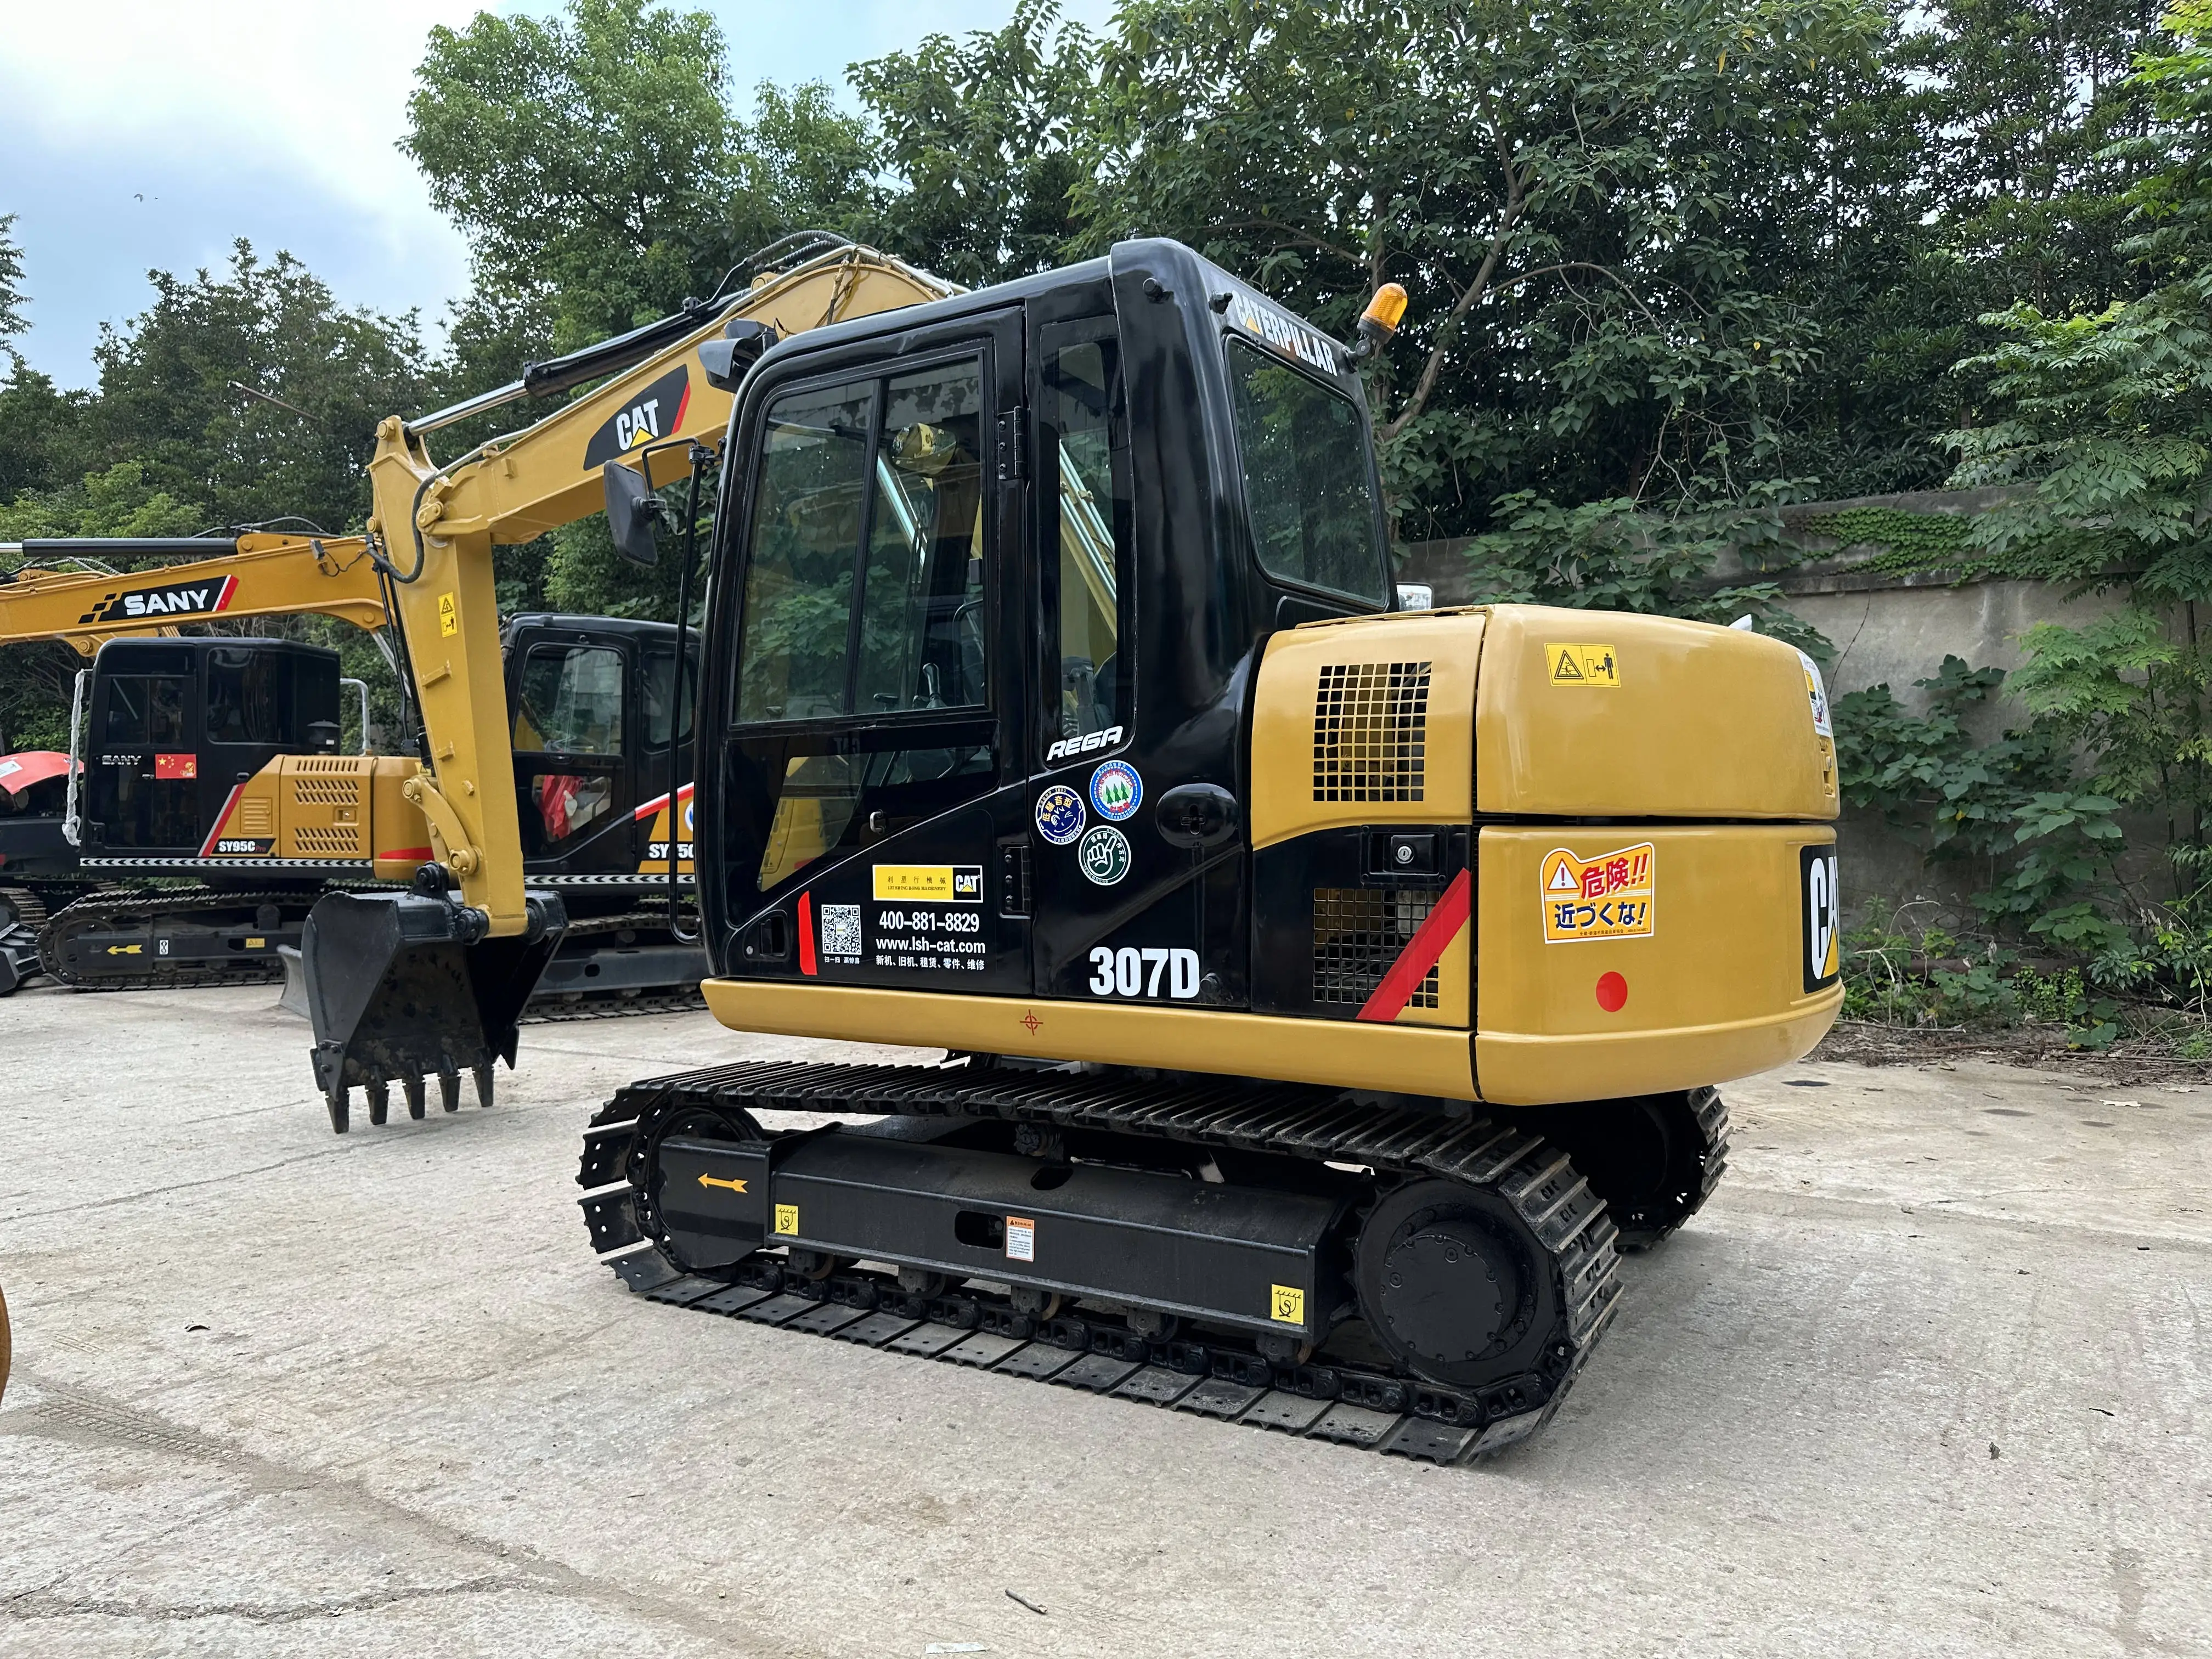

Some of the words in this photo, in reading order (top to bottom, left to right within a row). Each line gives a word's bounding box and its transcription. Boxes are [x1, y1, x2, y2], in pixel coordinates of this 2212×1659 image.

[1232, 290, 1338, 377] CATERPILLAR
[616, 399, 658, 450] CAT
[124, 589, 208, 616] SANY
[1046, 725, 1124, 761] REGA
[102, 755, 142, 765] SANY
[219, 840, 256, 852] SY95C
[1580, 854, 1648, 900] 危険!!
[879, 911, 979, 932] 400-881-8829
[1555, 901, 1646, 929] 近づくな!
[1810, 856, 1839, 980] CA
[876, 936, 986, 953] www.lsh-cat.com
[1090, 946, 1200, 998] 307D
